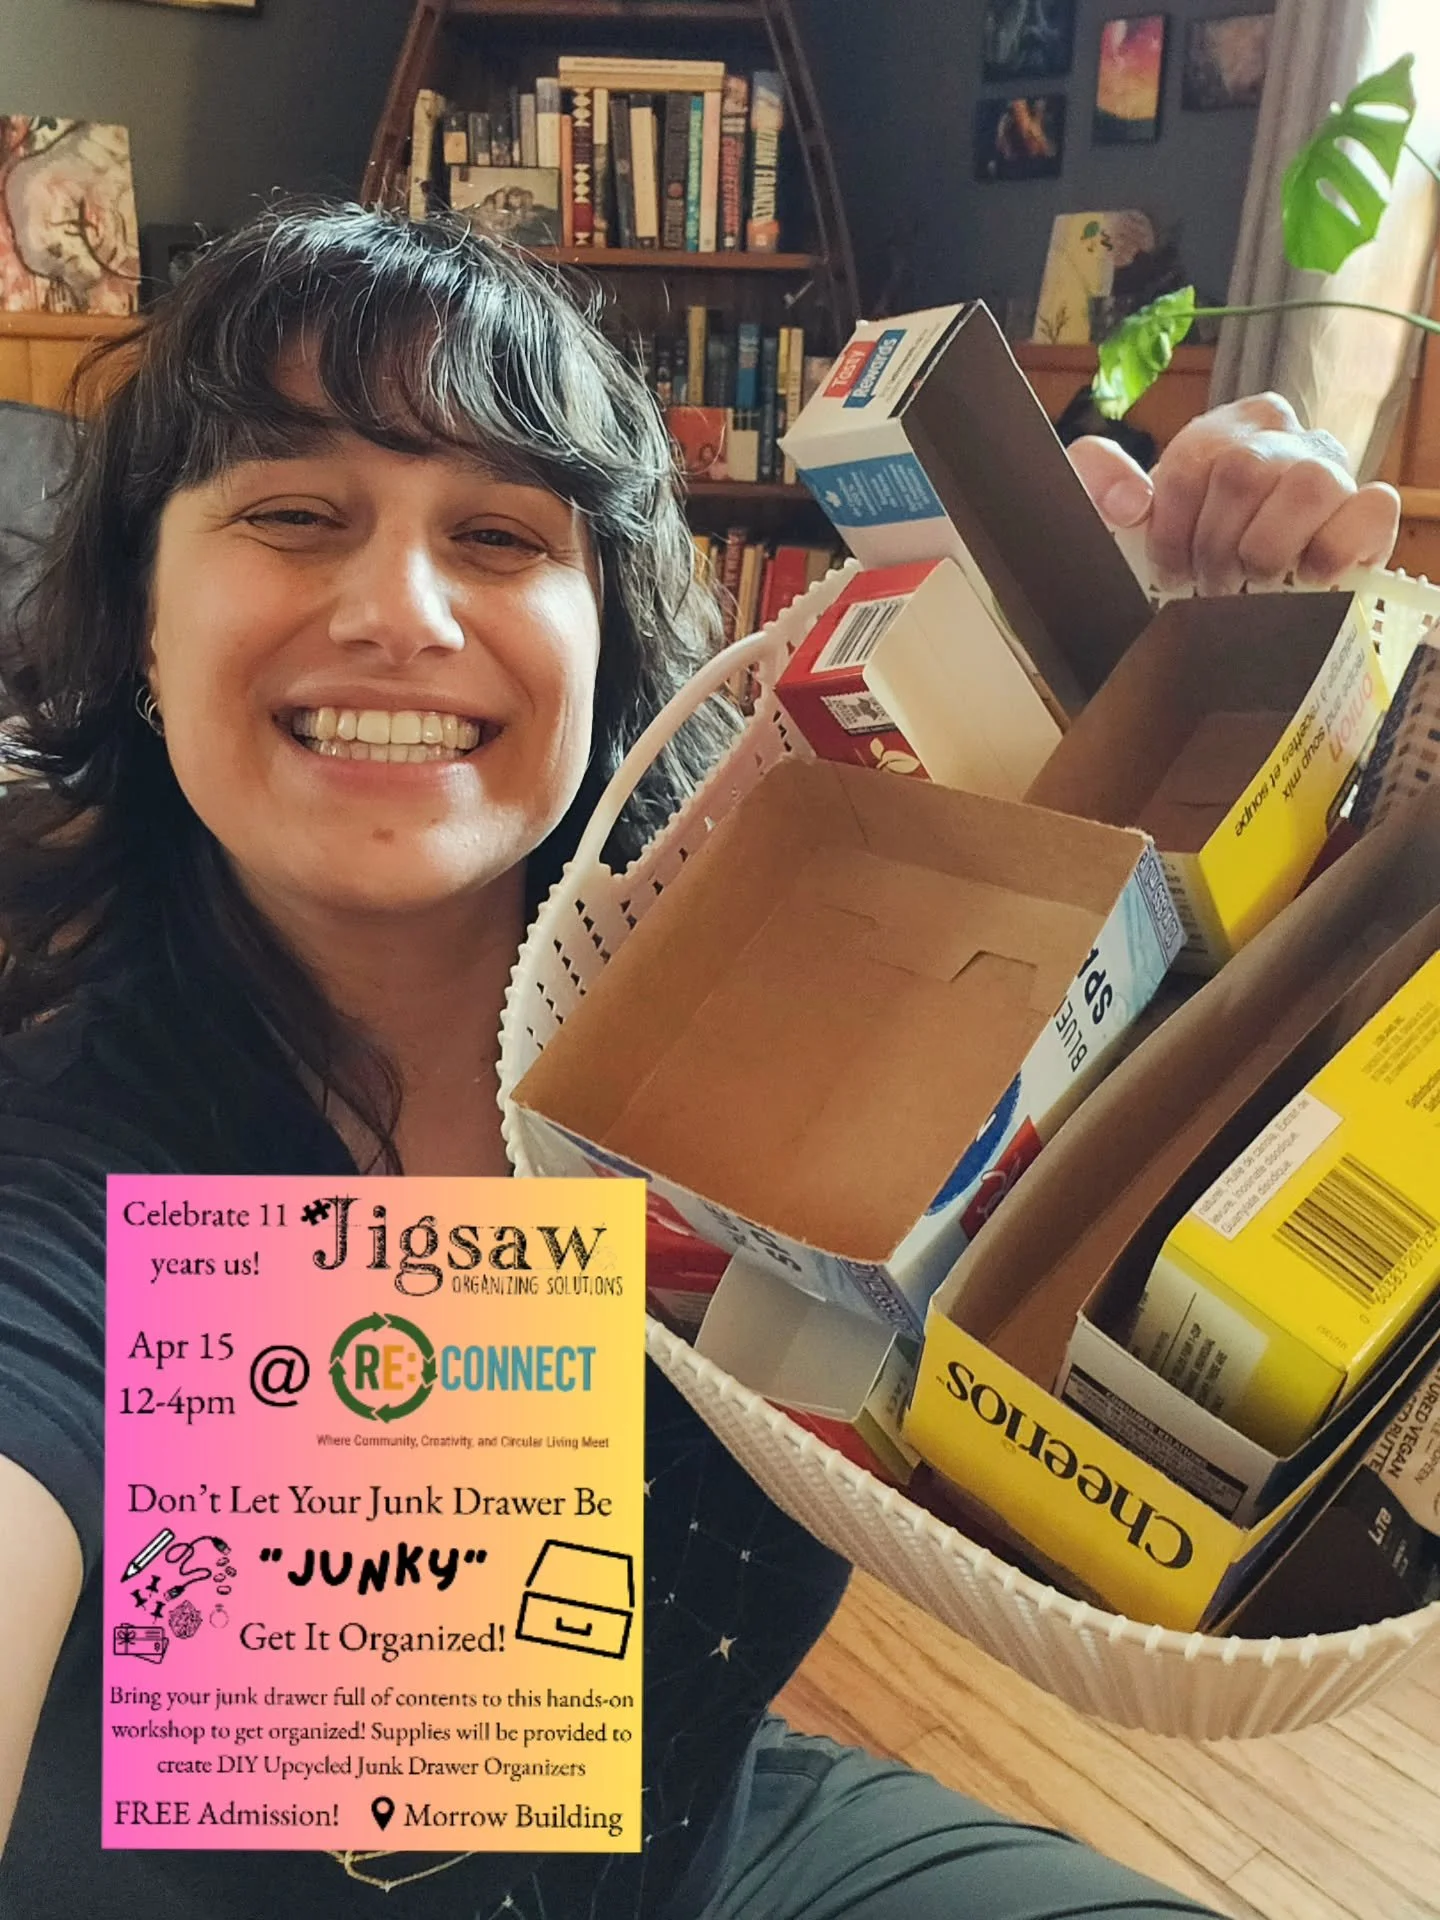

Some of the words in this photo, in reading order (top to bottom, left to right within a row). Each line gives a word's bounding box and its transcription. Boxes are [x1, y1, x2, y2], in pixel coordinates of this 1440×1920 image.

[831, 349, 866, 388] Tasty
[853, 337, 898, 398] Rewards
[1299, 725, 1327, 773] soup
[1268, 765, 1282, 791] et
[1282, 766, 1302, 803] mix
[1234, 786, 1269, 838] soupe
[1053, 993, 1088, 1073] BLUE
[946, 1361, 1194, 1569] Cheerios
[1387, 1425, 1423, 1480] VEGAN
